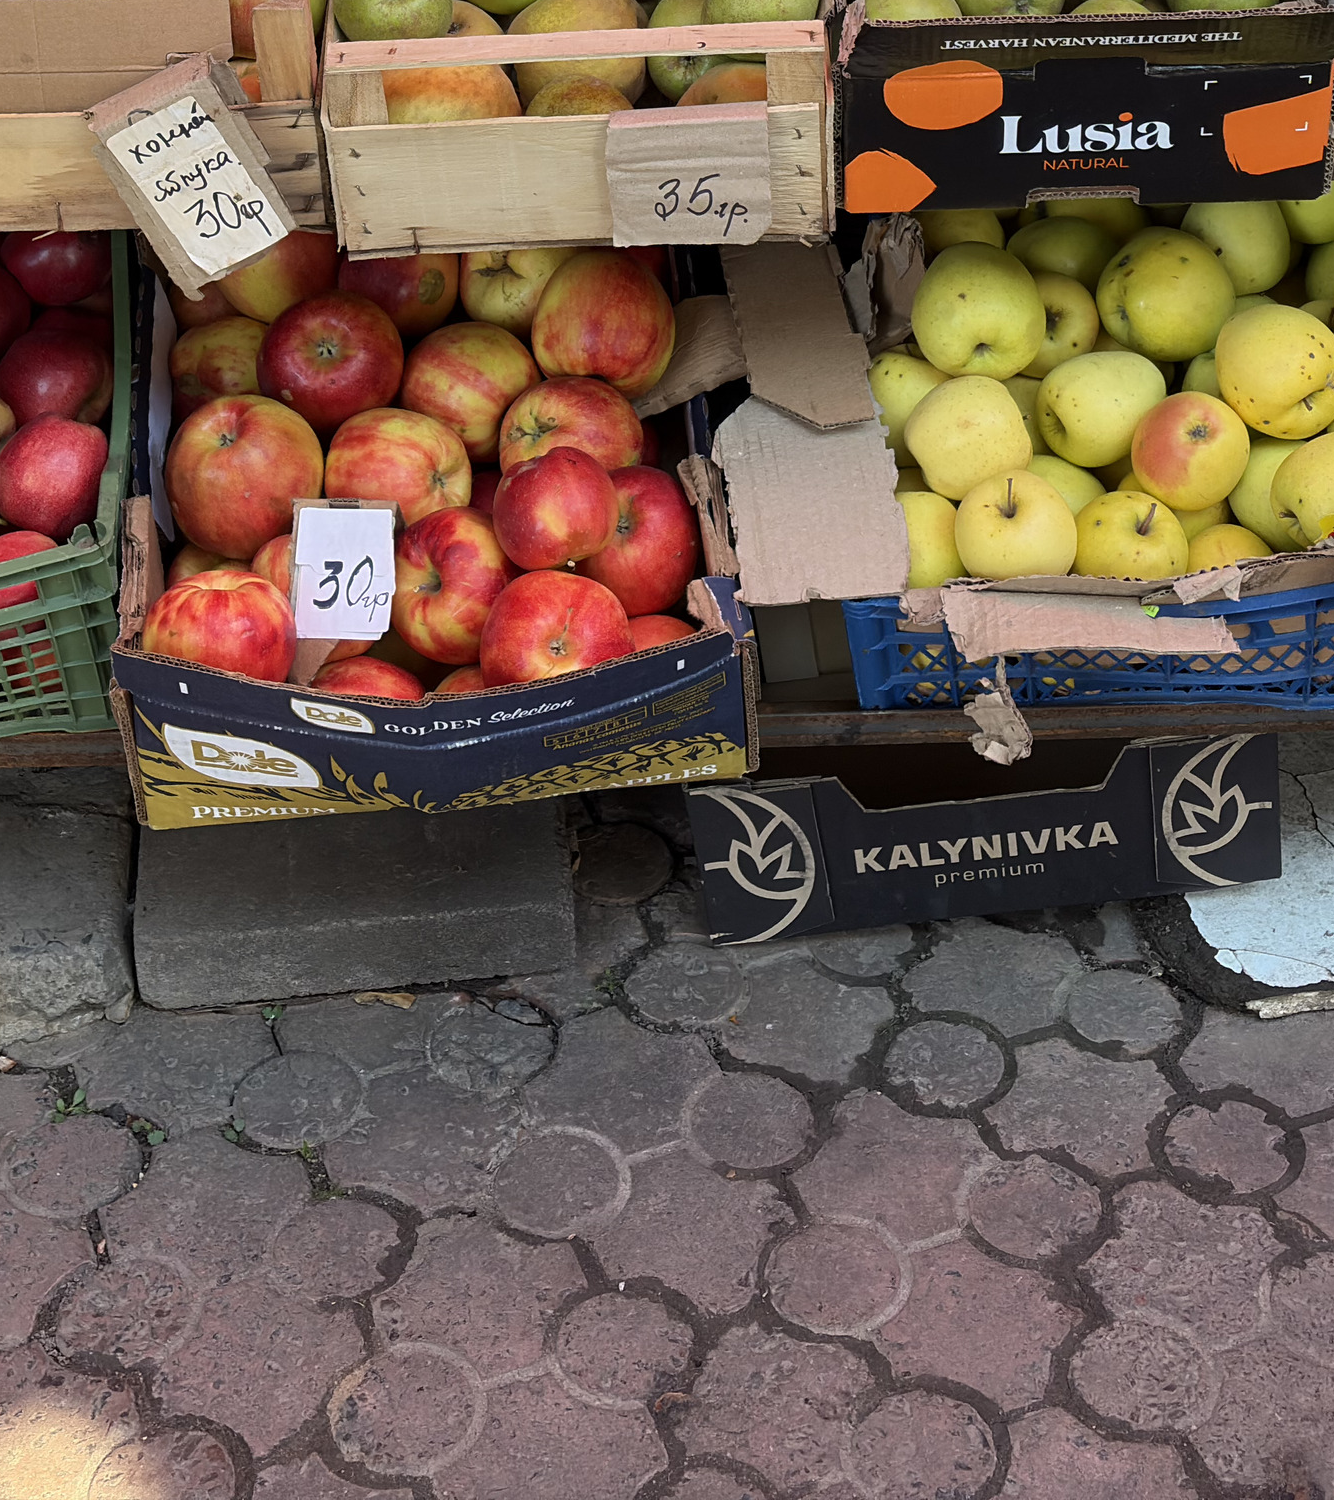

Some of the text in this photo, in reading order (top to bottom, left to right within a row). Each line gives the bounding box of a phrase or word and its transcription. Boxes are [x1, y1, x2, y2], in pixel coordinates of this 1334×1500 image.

[939, 29, 1243, 51] THE MEDITERRANEAN HARVEST
[999, 111, 1174, 155] Lusia
[1042, 155, 1130, 171] NATURAL
[304, 696, 576, 737] Dole GOLDEN Selection
[552, 732, 597, 751] Ananas
[189, 737, 299, 779] Dole
[191, 805, 338, 820] PREMIUM
[854, 820, 1121, 877] KALYNIVKA
[933, 862, 1047, 889] premium
